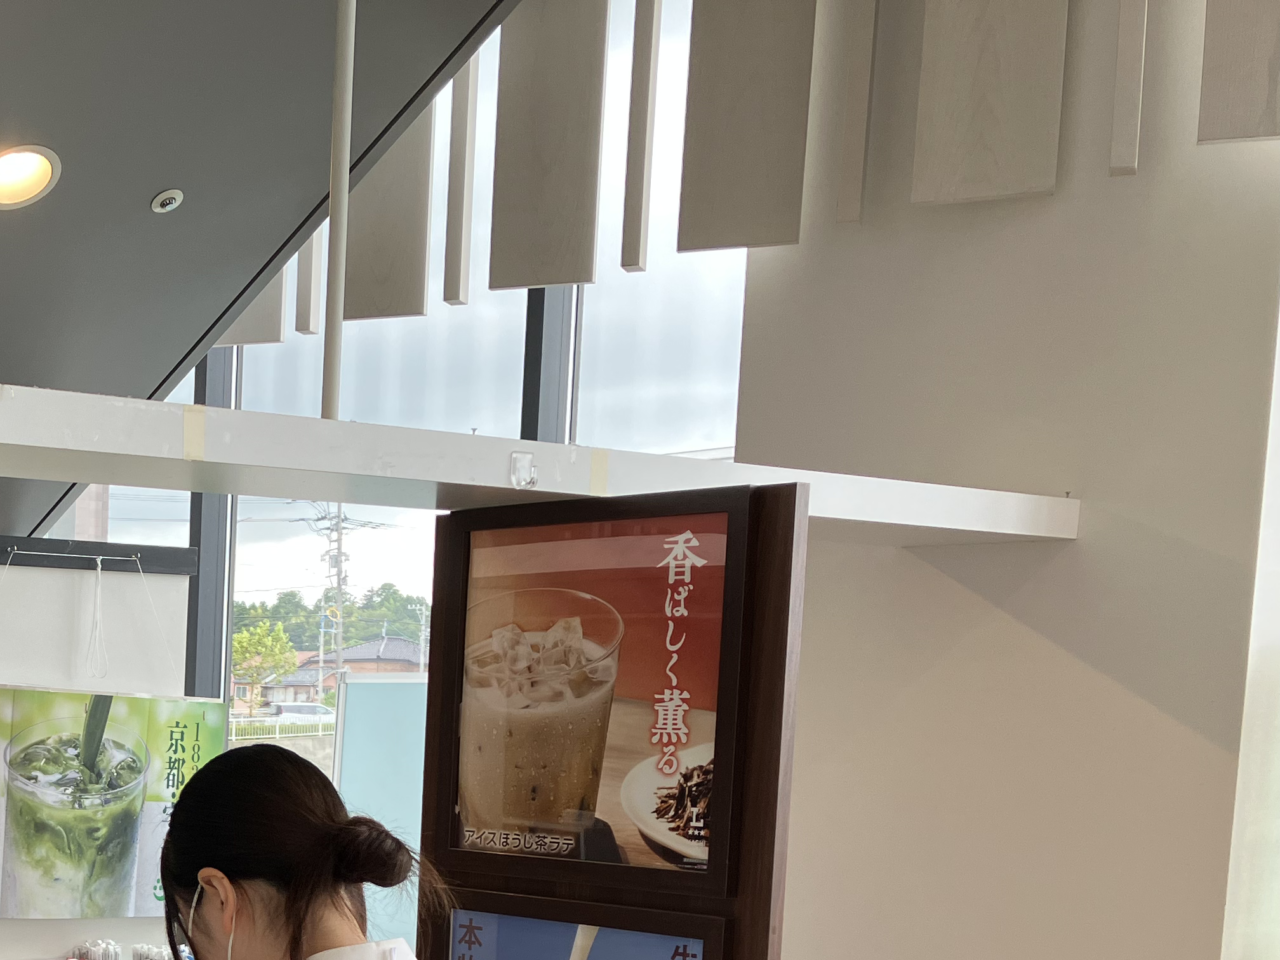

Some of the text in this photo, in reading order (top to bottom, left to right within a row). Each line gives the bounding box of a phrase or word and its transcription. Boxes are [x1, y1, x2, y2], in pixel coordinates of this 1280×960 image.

[651, 530, 708, 774] 香ばしく薫る
[464, 829, 574, 853] アイスほうじ茶ラテ
